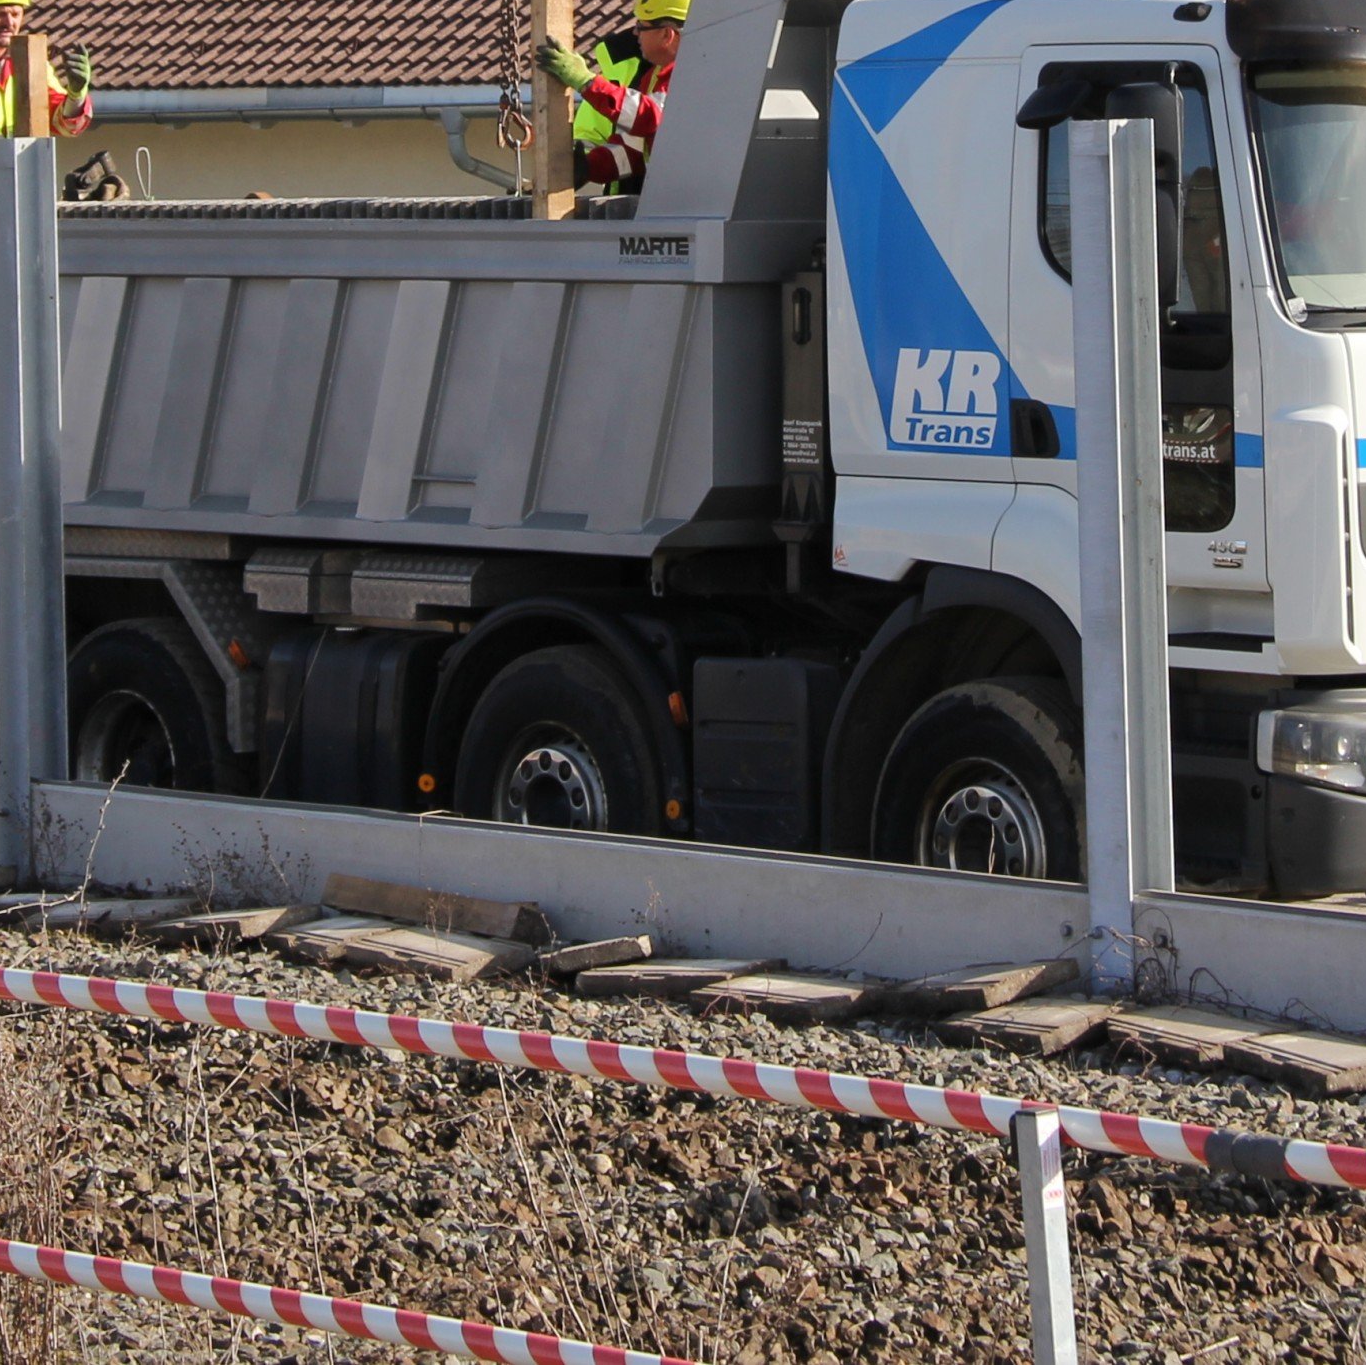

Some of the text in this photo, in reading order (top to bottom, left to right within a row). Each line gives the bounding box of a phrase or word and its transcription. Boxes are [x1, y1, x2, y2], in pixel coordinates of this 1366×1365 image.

[619, 236, 689, 256] MARTE
[892, 347, 1001, 415] KR
[905, 417, 991, 445] Trans
